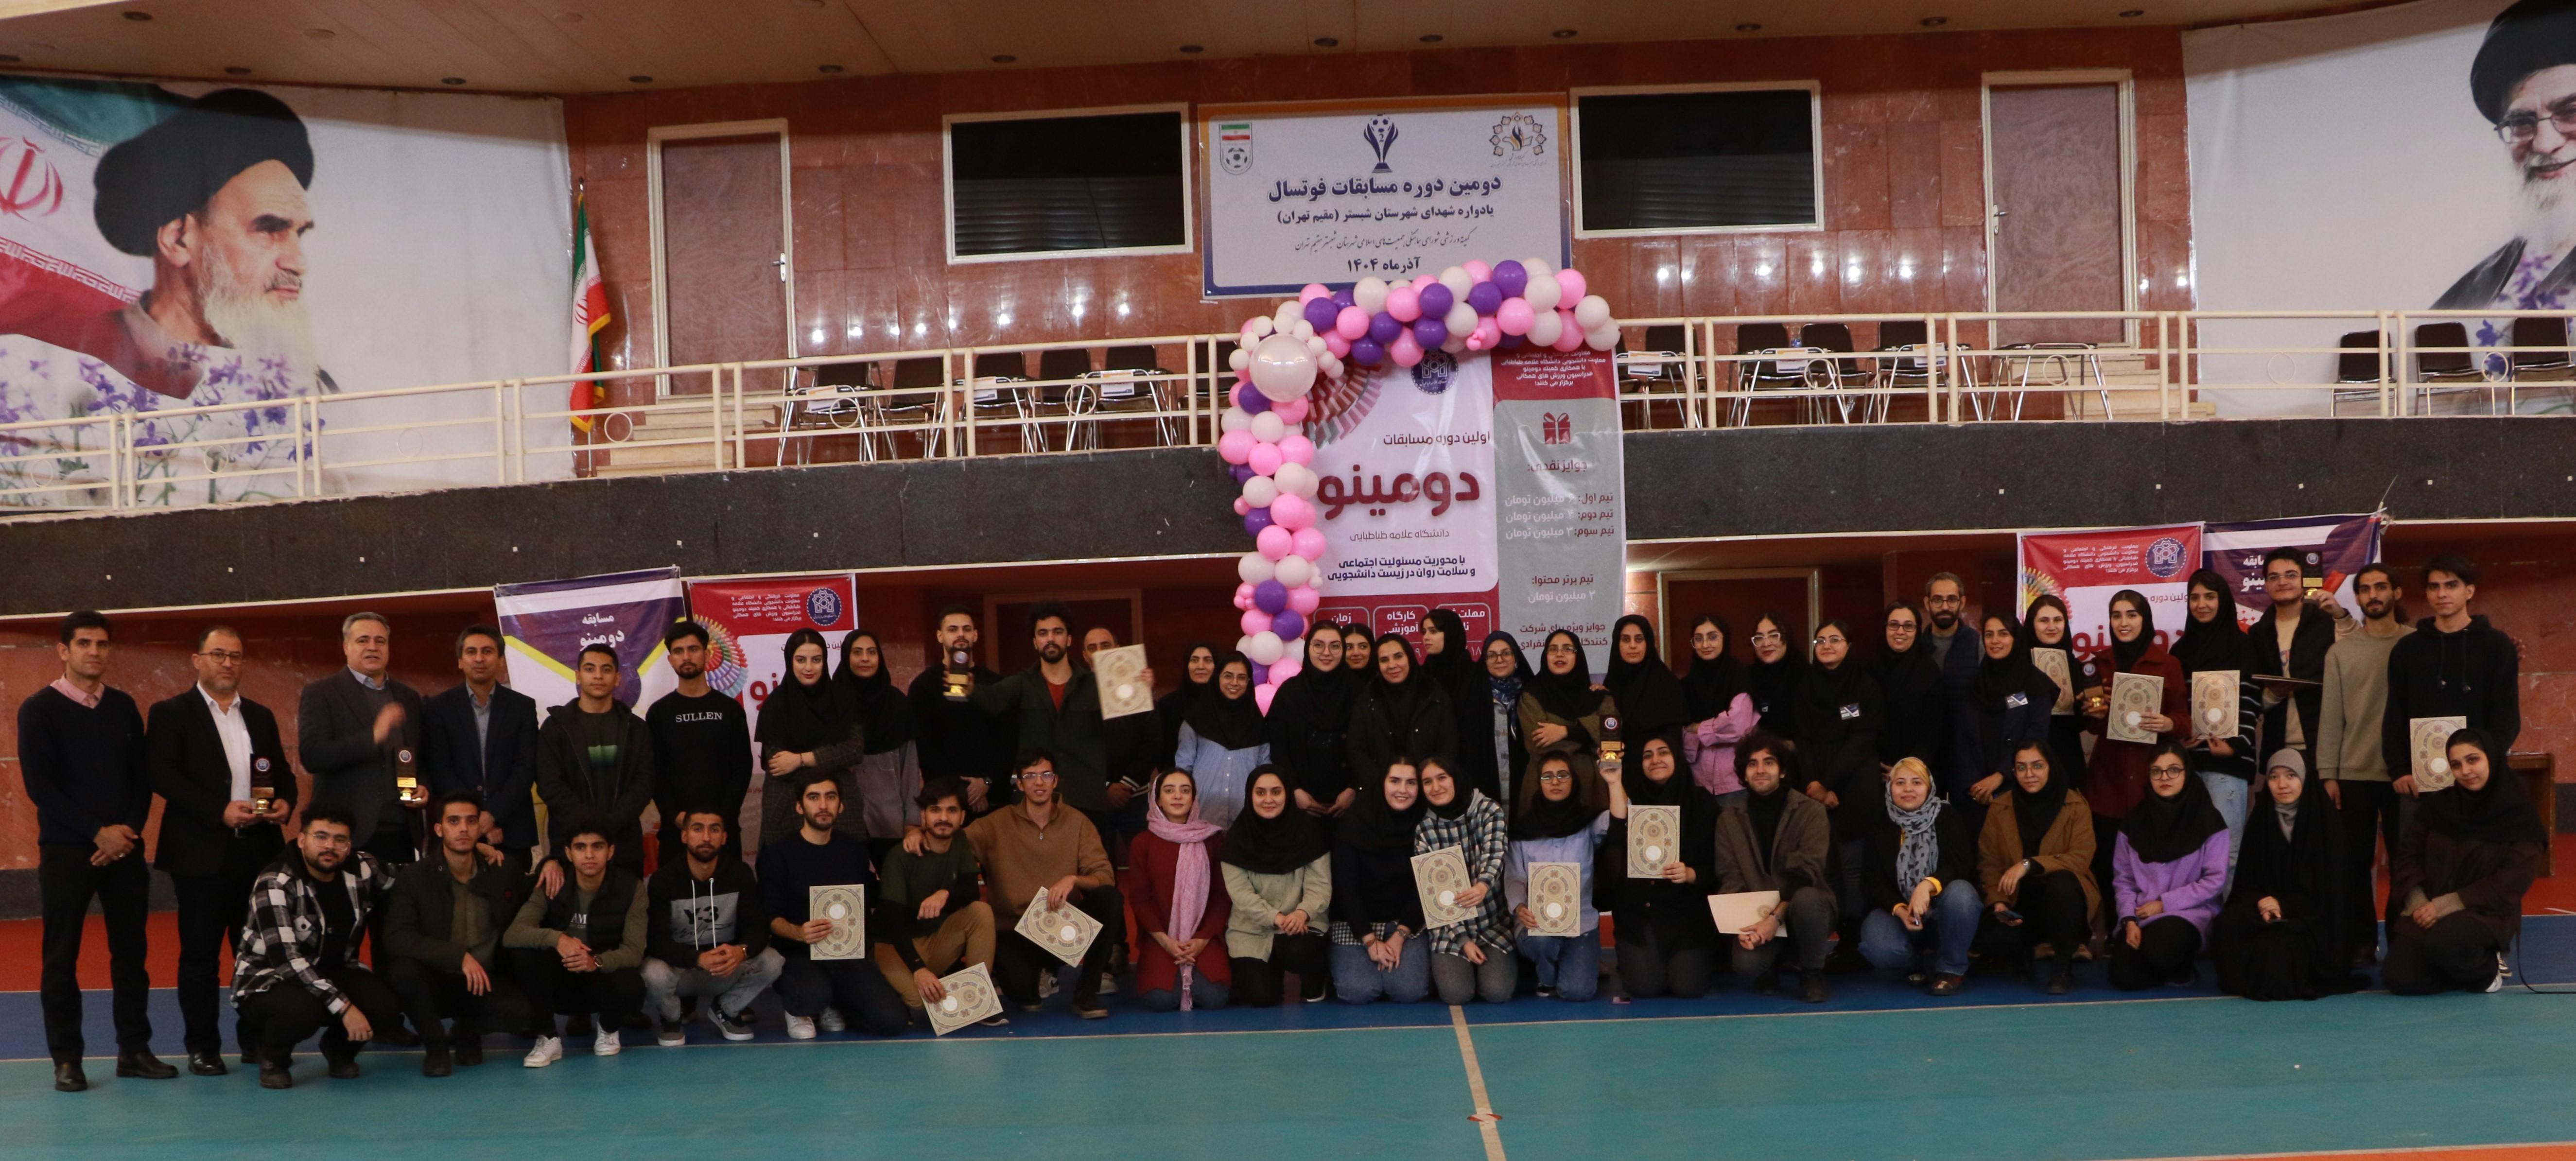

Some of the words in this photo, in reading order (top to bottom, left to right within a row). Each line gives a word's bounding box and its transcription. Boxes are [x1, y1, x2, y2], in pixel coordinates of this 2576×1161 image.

[1379, 133, 1384, 142] 2
[1269, 178, 1326, 202] فوتسال
[1332, 177, 1398, 199] مسابقات
[1403, 178, 1444, 198] دوره
[1449, 176, 1501, 196] دومین
[1277, 210, 1310, 224] تهران)
[1313, 208, 1340, 224] (مقیم
[1342, 208, 1372, 223] شبستر
[1375, 206, 1418, 221] شهرستان
[1421, 205, 1455, 220] شهدای
[1458, 204, 1494, 219] یادواره
[1347, 258, 1378, 272] ۱۴۰۴
[1383, 433, 1433, 447] مسابقات
[1436, 433, 1460, 446] دوره
[1462, 431, 1490, 445] اولین
[1562, 459, 1587, 472] جوایز
[1317, 464, 1480, 520] دومینو
[1599, 492, 1613, 504] تیم
[1505, 494, 1531, 506] تومان
[1533, 494, 1565, 505] میلیون
[1506, 511, 1531, 523] تومان
[1533, 510, 1564, 522] میلیون
[1599, 509, 1613, 520] تیم
[1389, 530, 1413, 539] علامه
[1414, 529, 1449, 538] دانشگاه
[1506, 528, 1531, 540] تومان
[1533, 527, 1564, 538] میلیون
[1600, 525, 1615, 537] تیم
[1339, 557, 1377, 569] اجتماعی
[1379, 557, 1422, 568] مسئولیت
[1423, 555, 1458, 567] محوریت
[1459, 555, 1465, 566] با
[1327, 569, 1376, 581] دانشجویی
[1377, 569, 1404, 579] زیست
[1406, 570, 1414, 579] در
[1416, 568, 1435, 578] روان
[1437, 566, 1468, 576] سلامت
[1470, 568, 1476, 577] و
[1532, 575, 1560, 587] محتوا:
[1562, 575, 1577, 586] برتر
[1579, 574, 1594, 586] تیم
[1528, 591, 1553, 603] تومان
[1556, 591, 1586, 603] میلیون
[1588, 590, 1596, 601] ۳
[2150, 594, 2168, 603] دوره
[1387, 610, 1416, 622] کارگاه
[1459, 608, 1485, 618] مهلت
[582, 612, 614, 627] مسابقه
[1520, 622, 1546, 634] شرکت
[1566, 622, 1584, 632] ویژه
[1585, 622, 1606, 633] جوایز
[1581, 637, 1608, 646] کنندگا
[675, 711, 723, 723] SULLEN
[683, 905, 719, 925] Y-3
